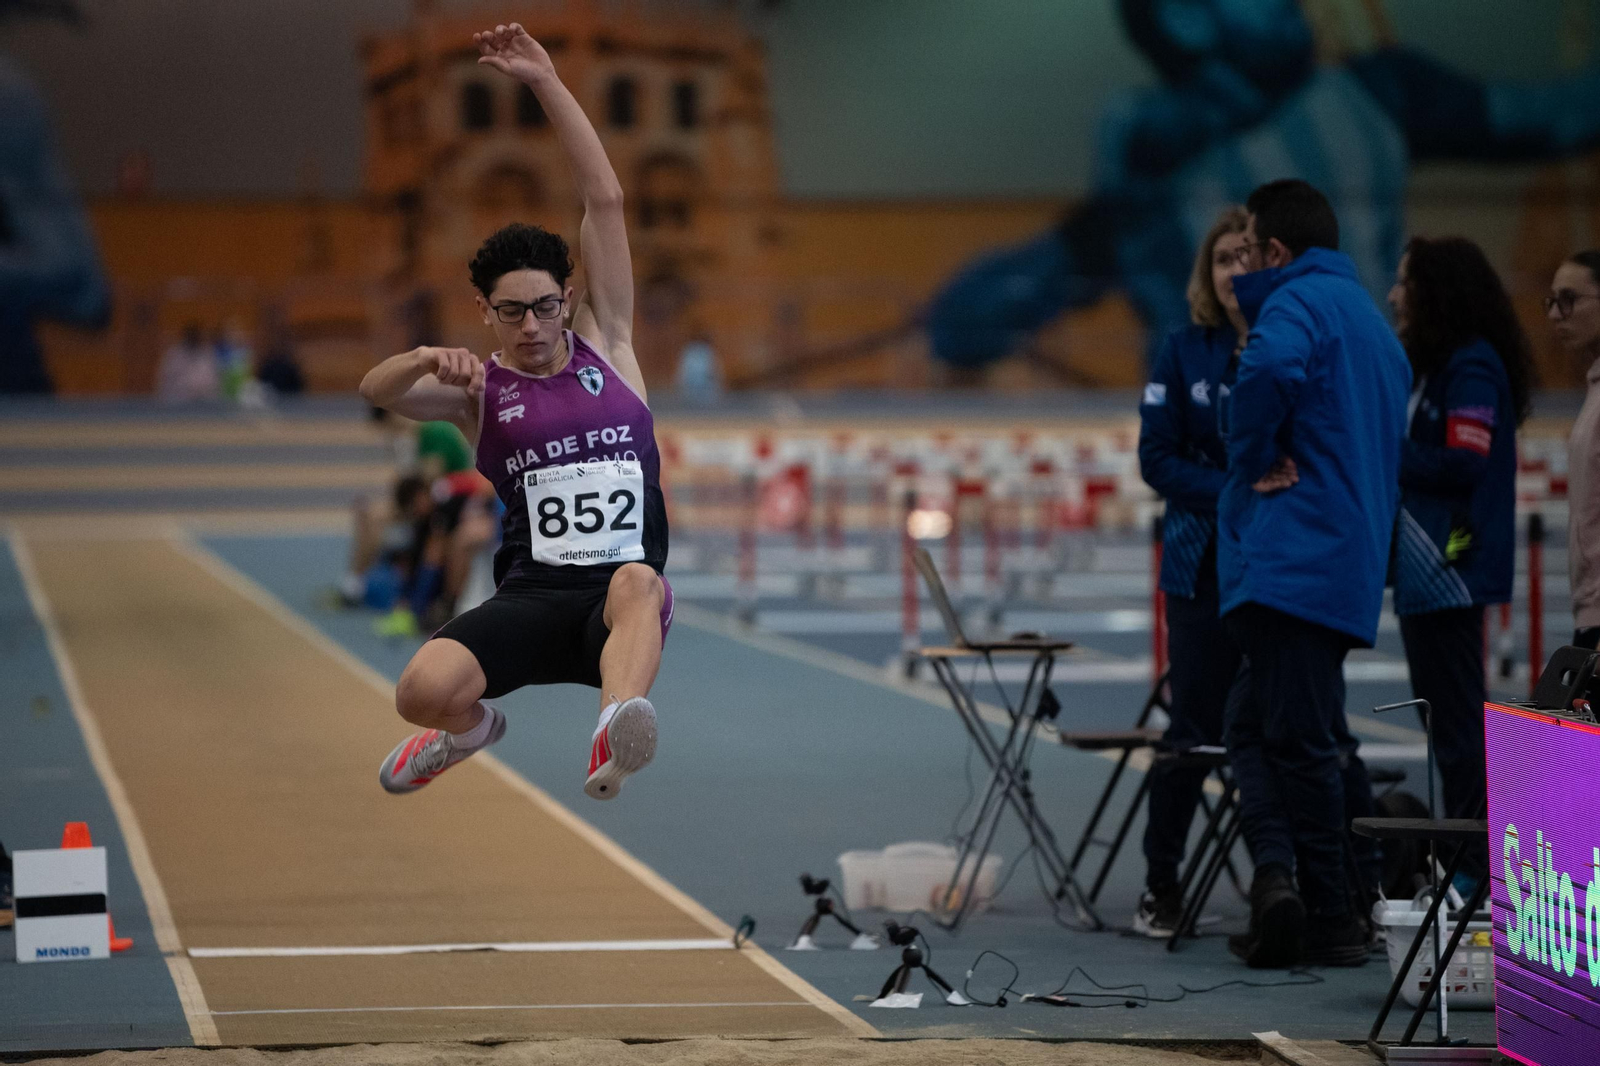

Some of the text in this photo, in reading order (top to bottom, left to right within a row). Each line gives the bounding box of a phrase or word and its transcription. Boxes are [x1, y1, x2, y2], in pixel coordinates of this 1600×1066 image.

[505, 448, 541, 475] RÍA
[545, 435, 580, 459] DE
[585, 425, 633, 449] FOZ
[538, 470, 560, 478] XUNTA
[548, 475, 574, 484] GALICIA
[537, 489, 637, 539] 852
[559, 546, 621, 561] atletismo.gal
[1504, 823, 1577, 978] Salto
[36, 946, 91, 959] MONDO
